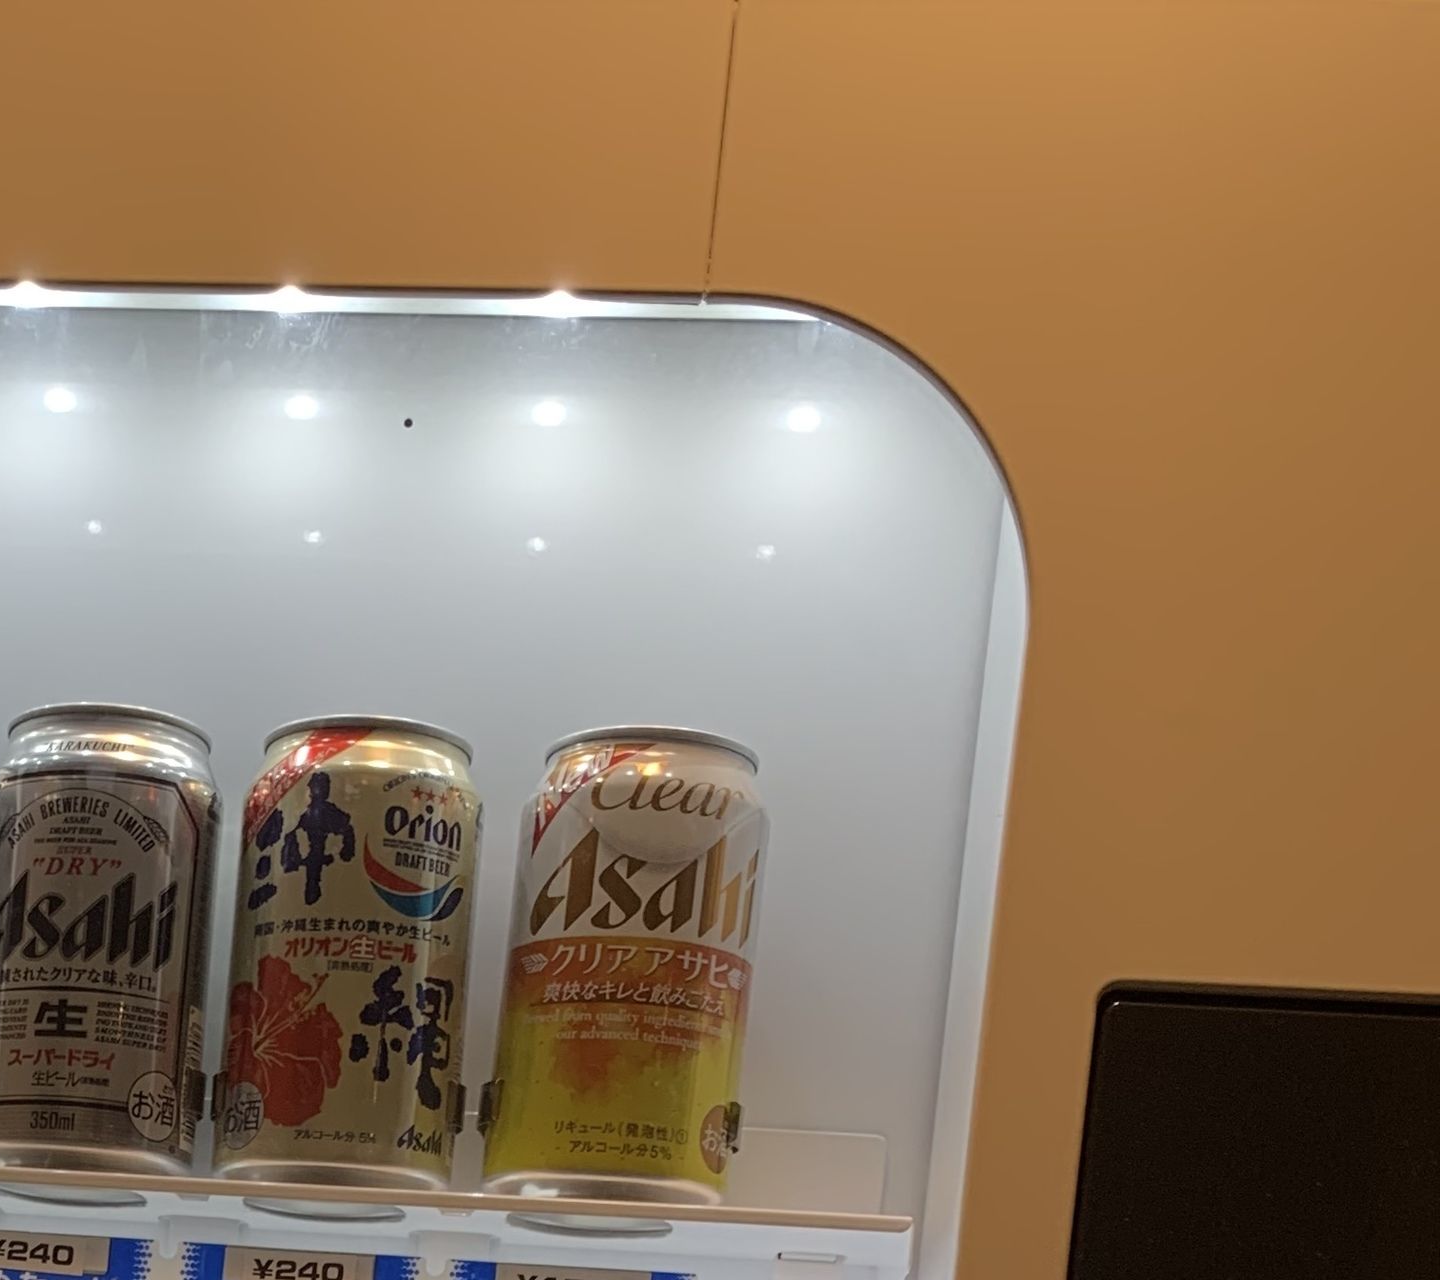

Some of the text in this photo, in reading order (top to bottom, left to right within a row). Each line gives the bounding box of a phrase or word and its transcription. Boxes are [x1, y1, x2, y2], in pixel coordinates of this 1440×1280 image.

[590, 771, 746, 821] Clear
[40, 795, 110, 821] BREWERIES
[113, 808, 156, 853] LIMITED
[529, 826, 761, 950] Asahi
[283, 934, 418, 964] オリオン生ビール
[34, 999, 88, 1039] 生
[8, 1049, 116, 1071] スーパードライ
[29, 1110, 76, 1132] 350ml
[131, 1089, 176, 1129] お酒
[397, 1123, 442, 1157] Asahi
